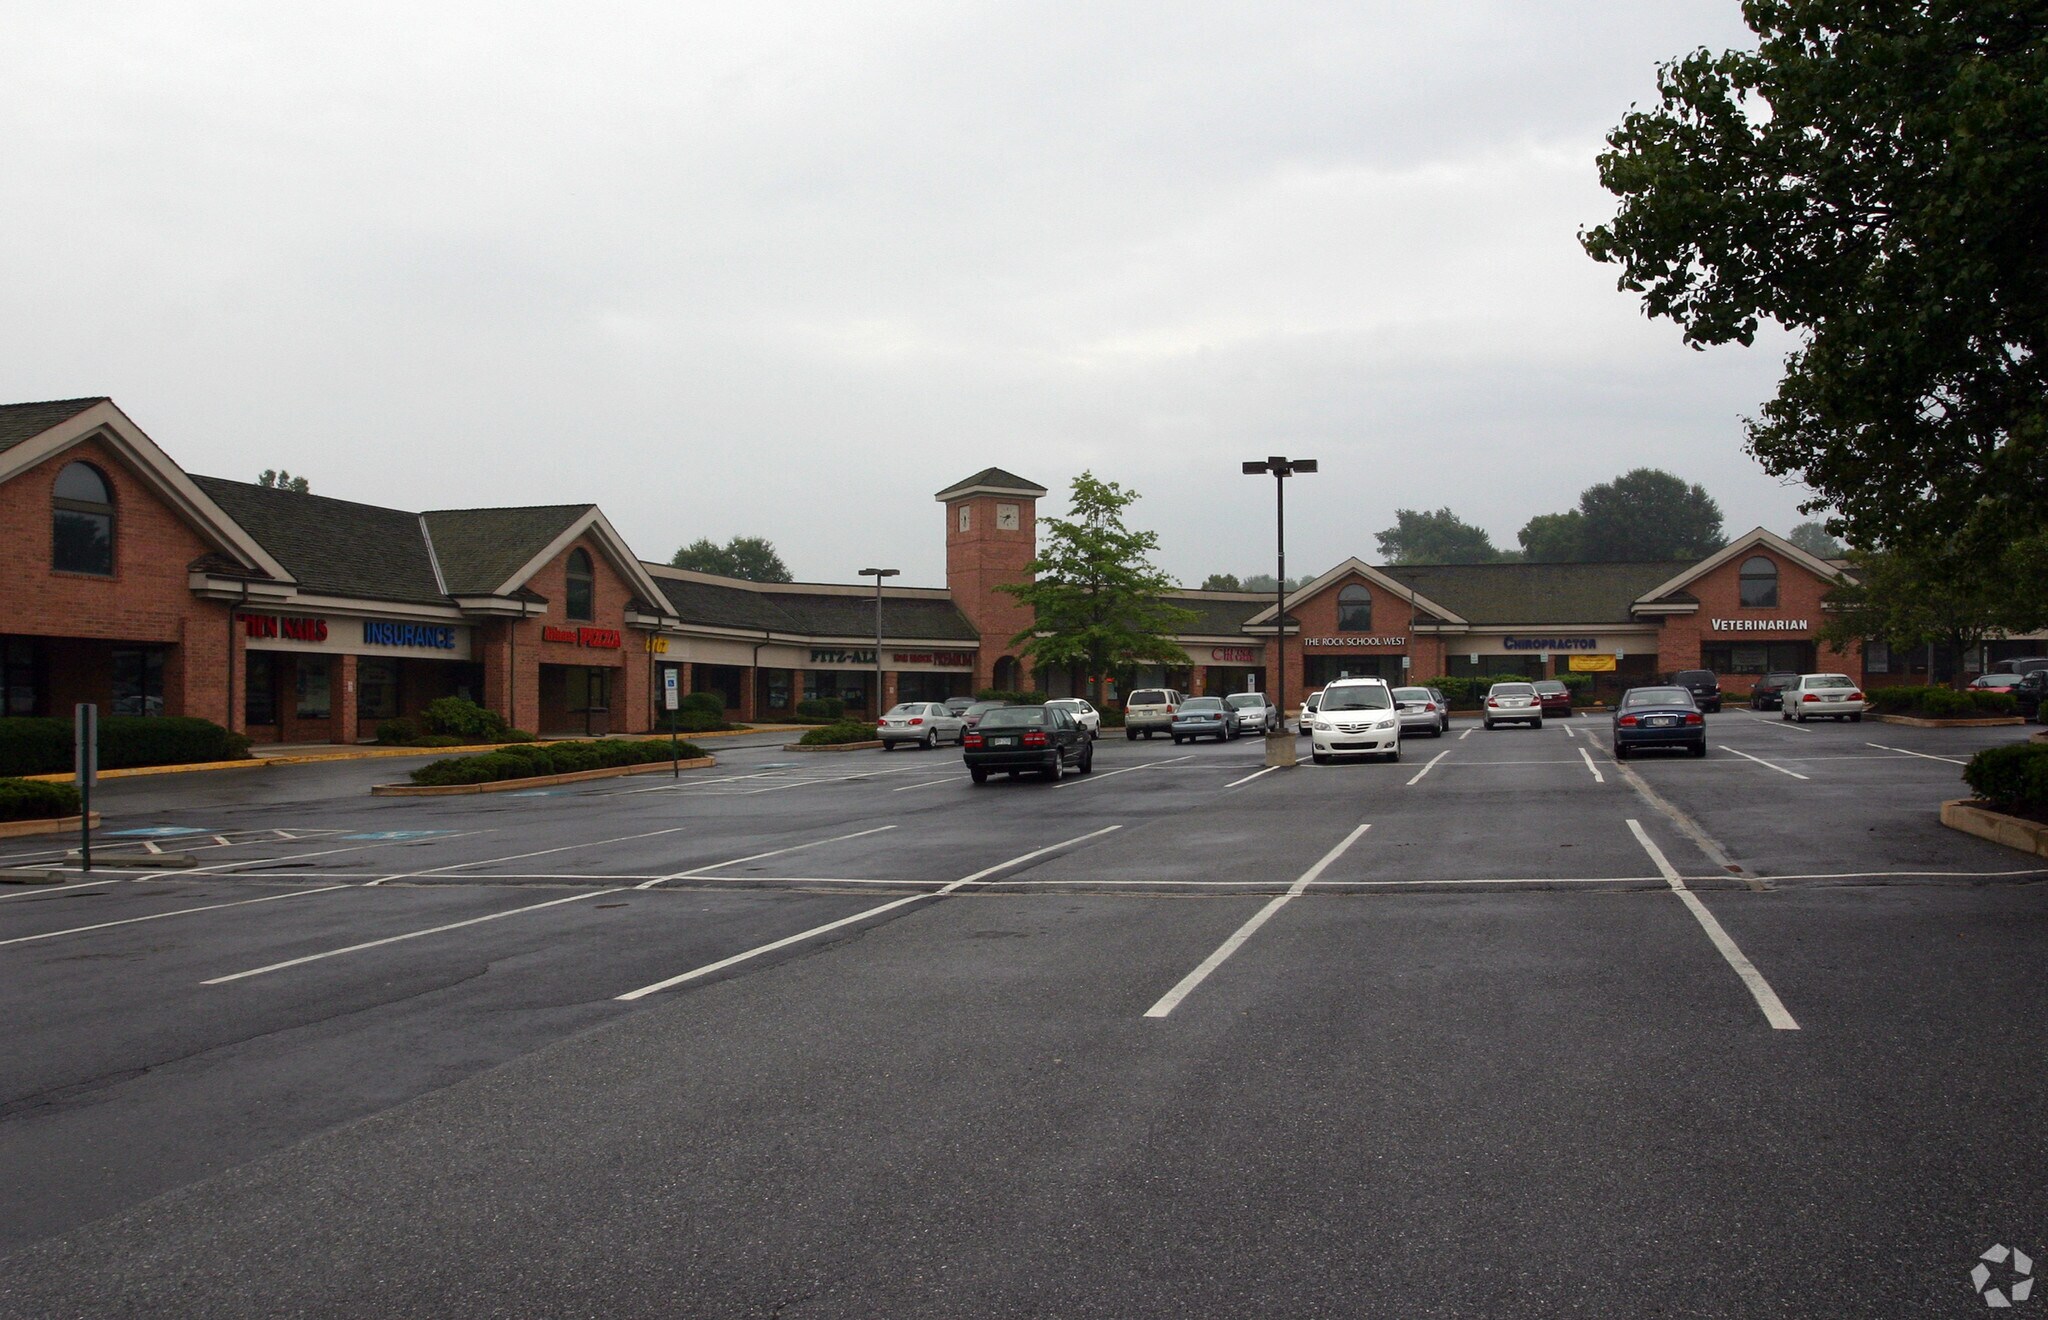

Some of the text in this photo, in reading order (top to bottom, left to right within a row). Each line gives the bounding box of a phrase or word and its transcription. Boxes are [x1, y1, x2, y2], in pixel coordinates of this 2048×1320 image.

[281, 616, 328, 641] NAILS
[1711, 618, 1808, 631] VETERINARIAN
[364, 622, 456, 649] INSURANCE
[578, 627, 621, 649] PIZZA
[1304, 637, 1406, 646] THE ROCK SCHOOL WEST
[1504, 636, 1597, 650] CHIROPRACTOR
